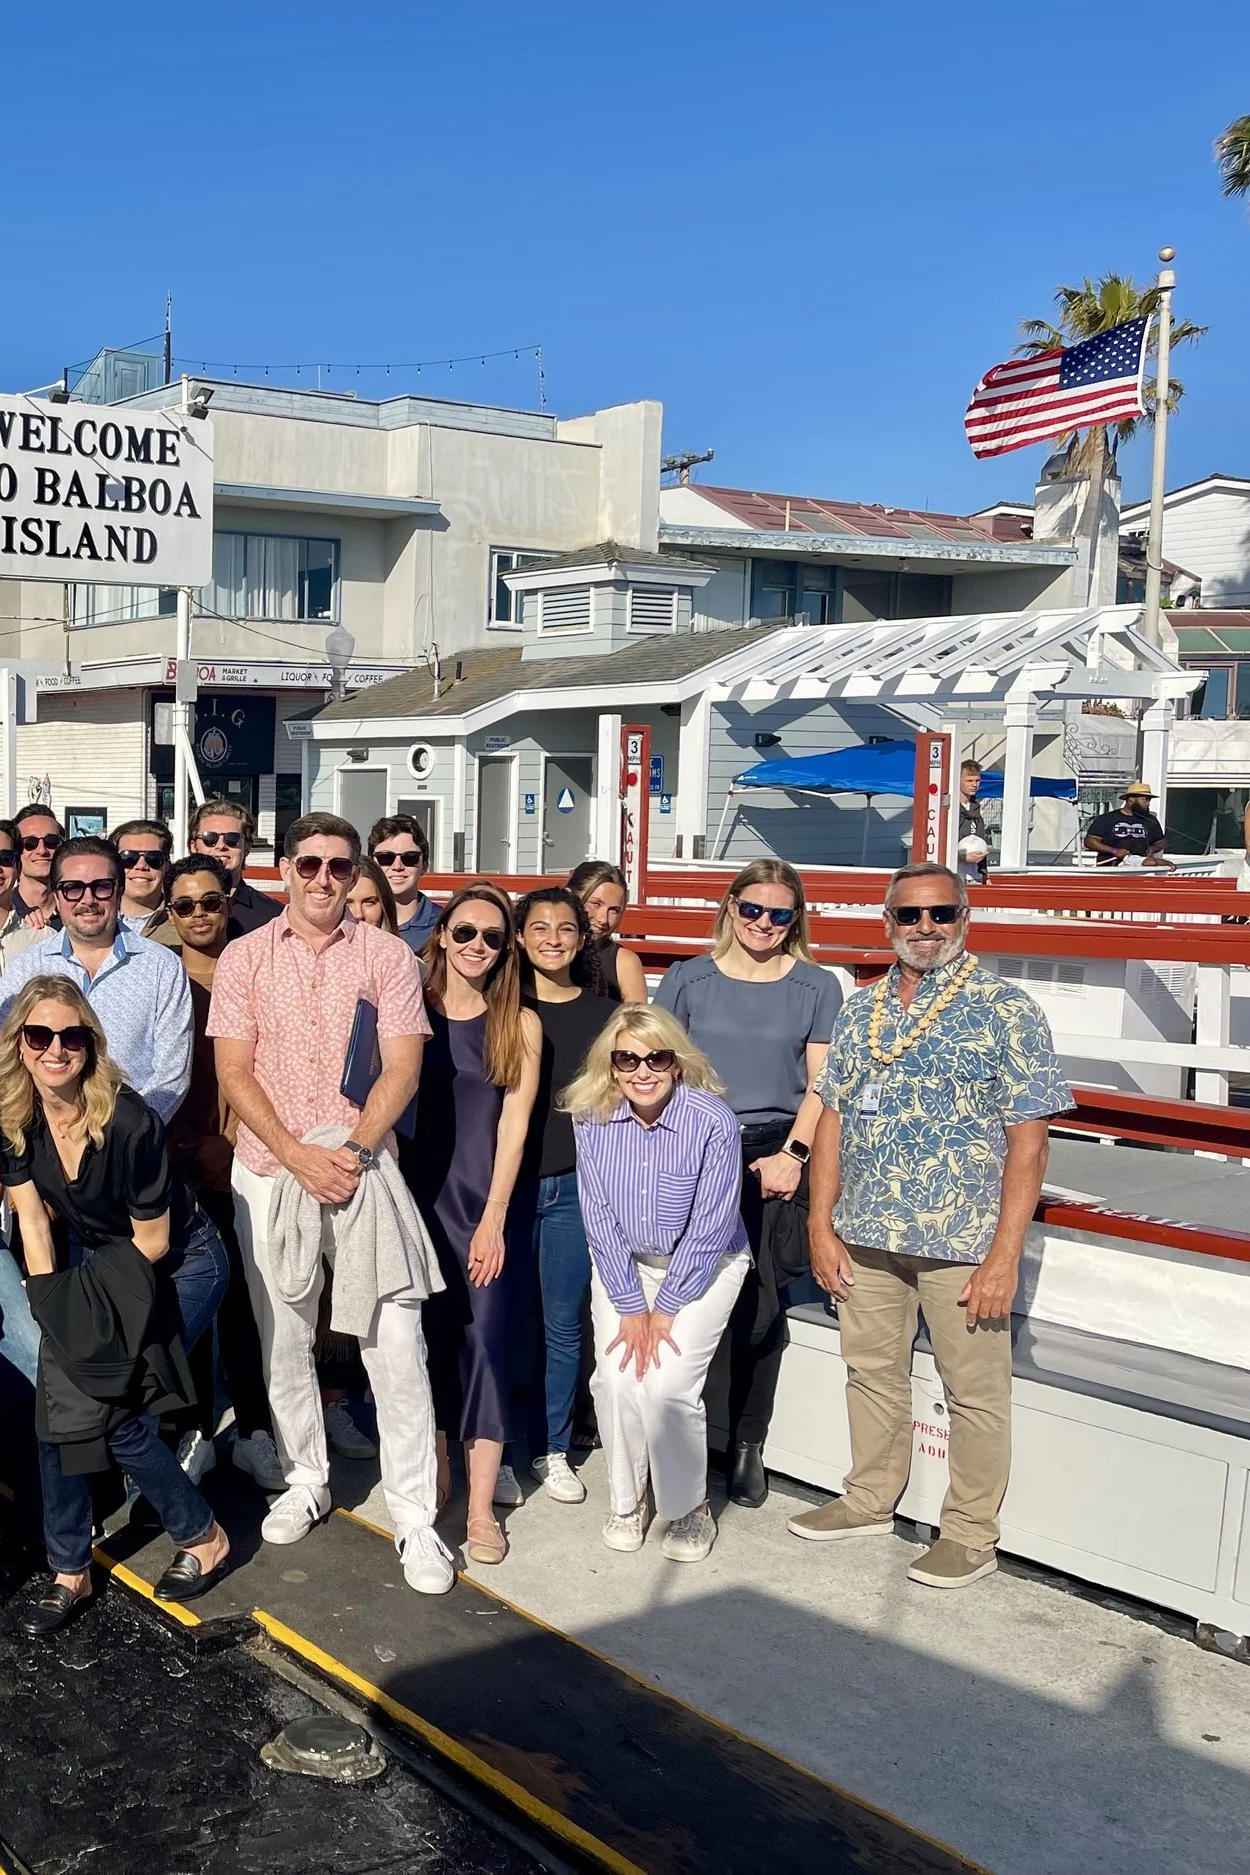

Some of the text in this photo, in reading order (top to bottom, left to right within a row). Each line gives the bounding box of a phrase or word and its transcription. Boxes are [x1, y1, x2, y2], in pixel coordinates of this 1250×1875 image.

[33, 466, 202, 519] BALBOA
[1, 515, 158, 564] ISLAND
[45, 677, 58, 687] FOOD
[280, 672, 312, 682] LIQUOR
[354, 674, 383, 684] COFFEE
[630, 740, 638, 754] 3
[932, 746, 939, 758] 3
[926, 809, 937, 863] CAU
[912, 1421, 950, 1441] PRESE
[918, 1442, 946, 1459] ADU
